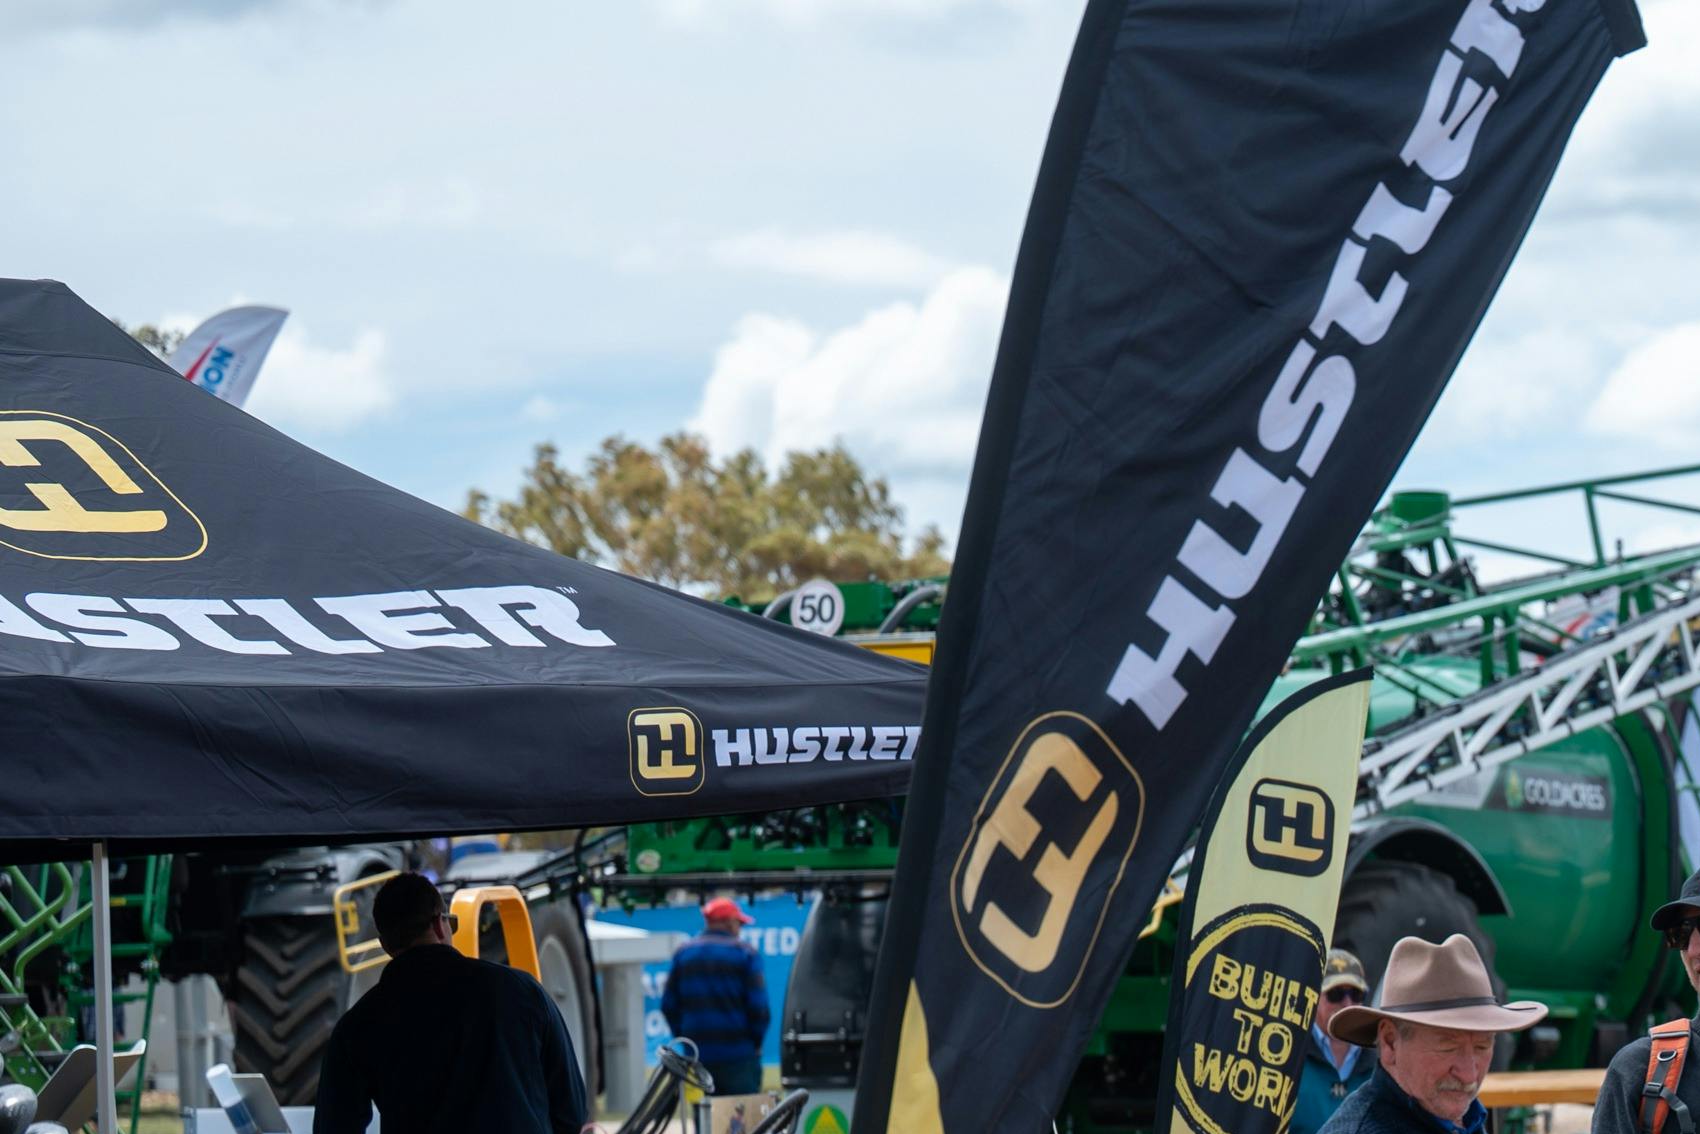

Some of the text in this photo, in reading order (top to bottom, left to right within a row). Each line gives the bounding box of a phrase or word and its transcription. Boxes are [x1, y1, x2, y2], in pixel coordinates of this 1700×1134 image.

[0, 585, 616, 656] STLER
[799, 594, 836, 624] 50
[712, 725, 922, 767] HUSTLE
[1209, 953, 1320, 1031] BUILT
[1233, 1008, 1293, 1066] TO
